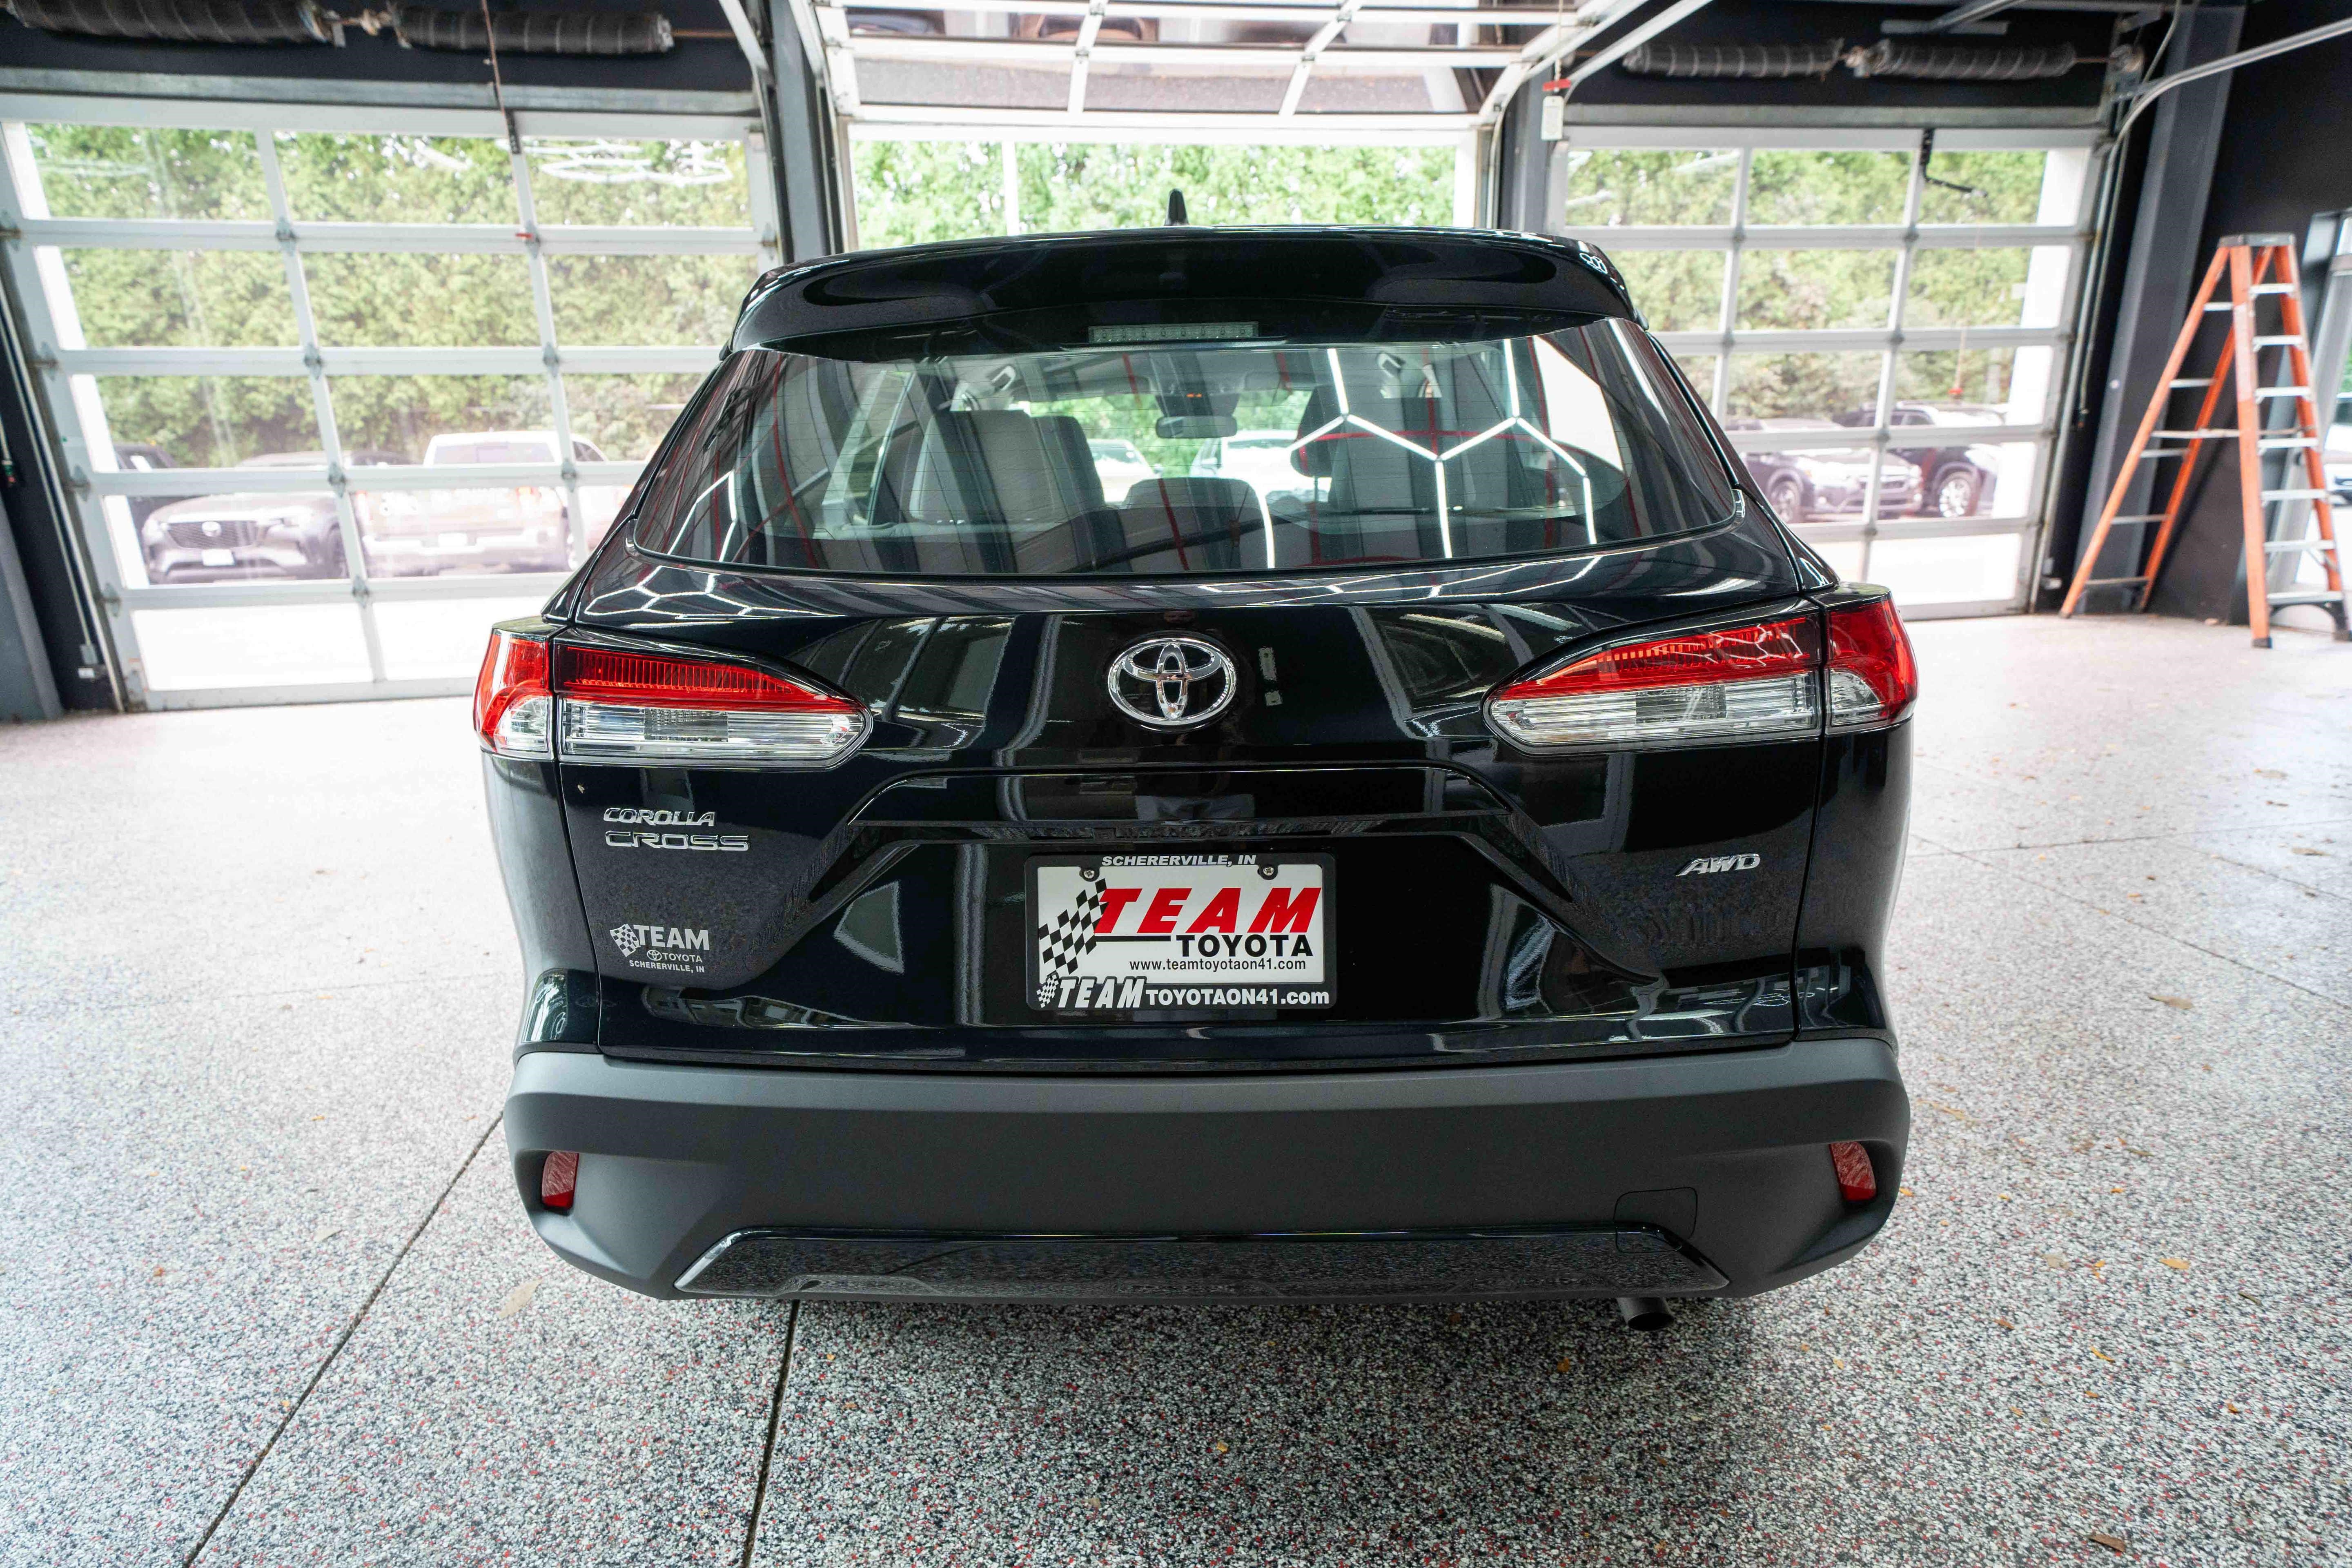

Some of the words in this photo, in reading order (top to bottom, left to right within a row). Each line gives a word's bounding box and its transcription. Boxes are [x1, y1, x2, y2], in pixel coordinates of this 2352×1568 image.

[604, 807, 715, 826] COROLLA
[605, 830, 749, 851] CROSS
[1101, 855, 1232, 867] SCHERERVILLE,
[1238, 855, 1256, 865] IN
[1675, 853, 1761, 876] AWD
[1094, 887, 1321, 933] TEAM
[633, 924, 710, 951] TEAM
[1176, 934, 1313, 957] TOYOTA
[629, 960, 694, 973] SCHERERVILLE,
[662, 952, 703, 963] TOYOTA
[1129, 958, 1306, 972] www.teamtoyotaon41.com
